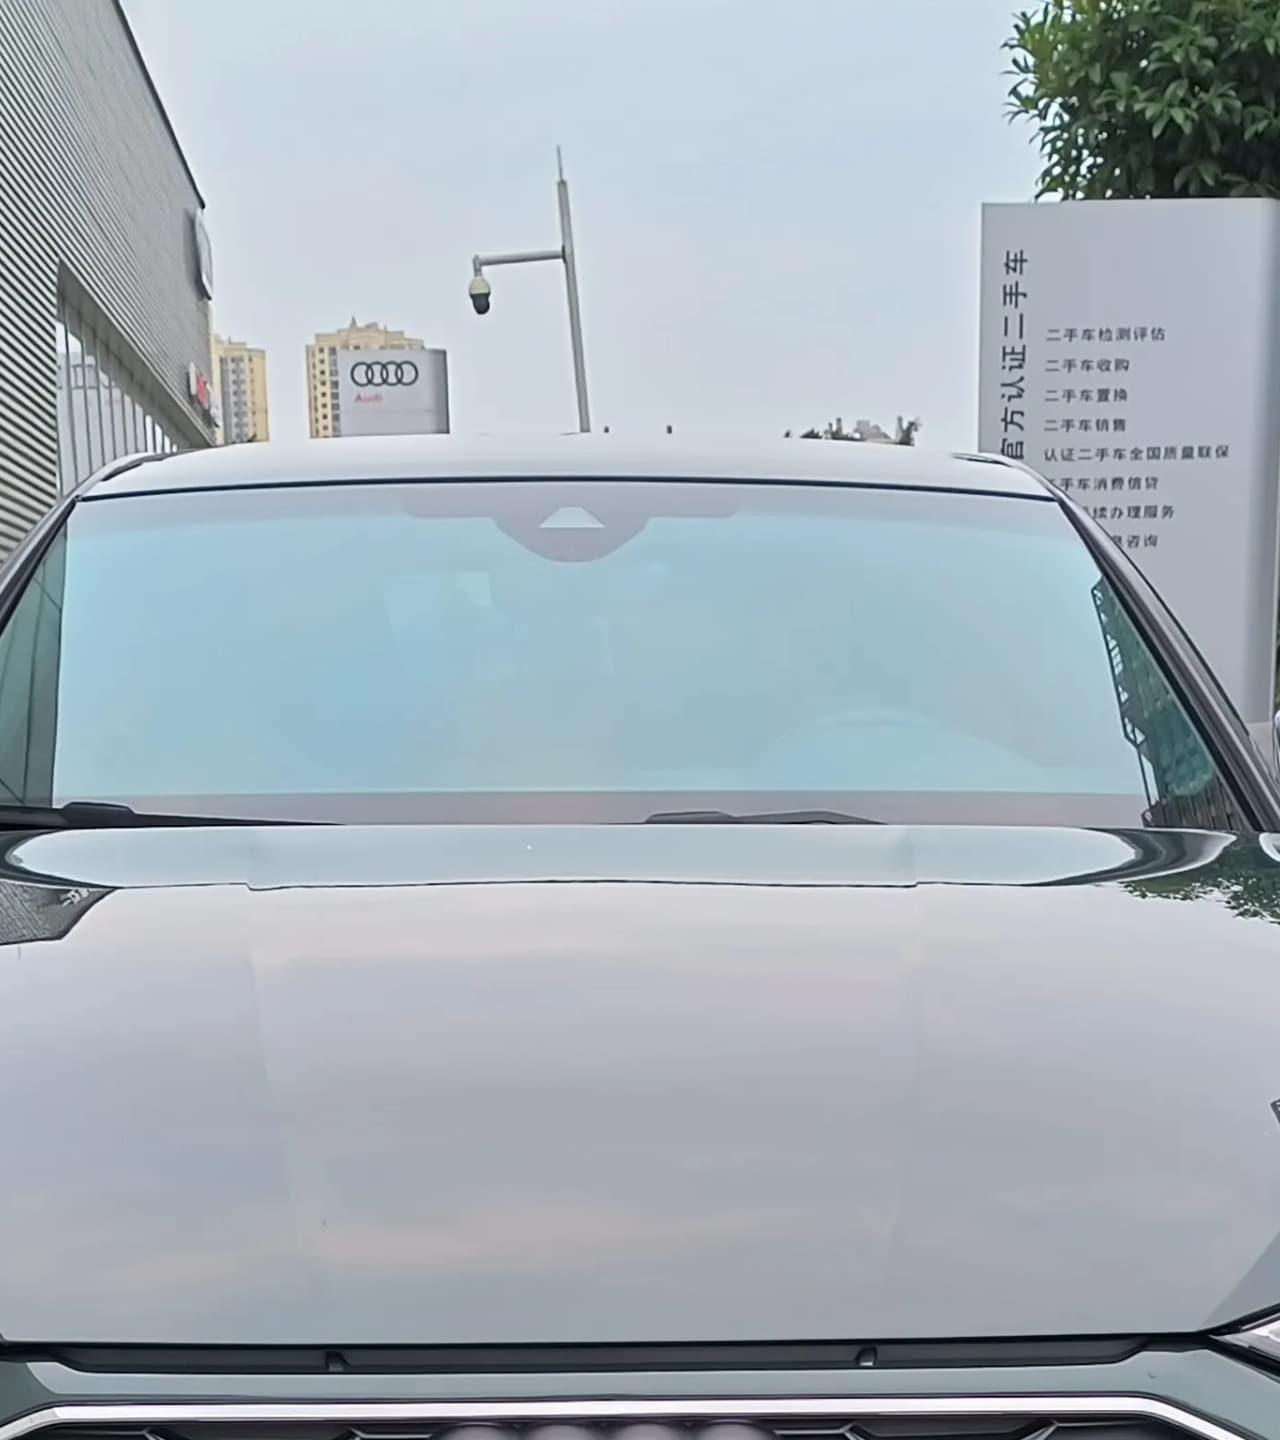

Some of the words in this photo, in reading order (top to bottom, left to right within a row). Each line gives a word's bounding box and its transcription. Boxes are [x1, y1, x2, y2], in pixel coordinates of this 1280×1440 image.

[1045, 327, 1166, 342] 二手车检测评估
[1000, 249, 1028, 460] 官方认证二手车
[1045, 358, 1130, 373] 二手车收购
[1044, 388, 1128, 403] 二手车置换
[1043, 418, 1126, 432] 二手车销售
[1044, 445, 1229, 462] 认证二手车全国质量联保
